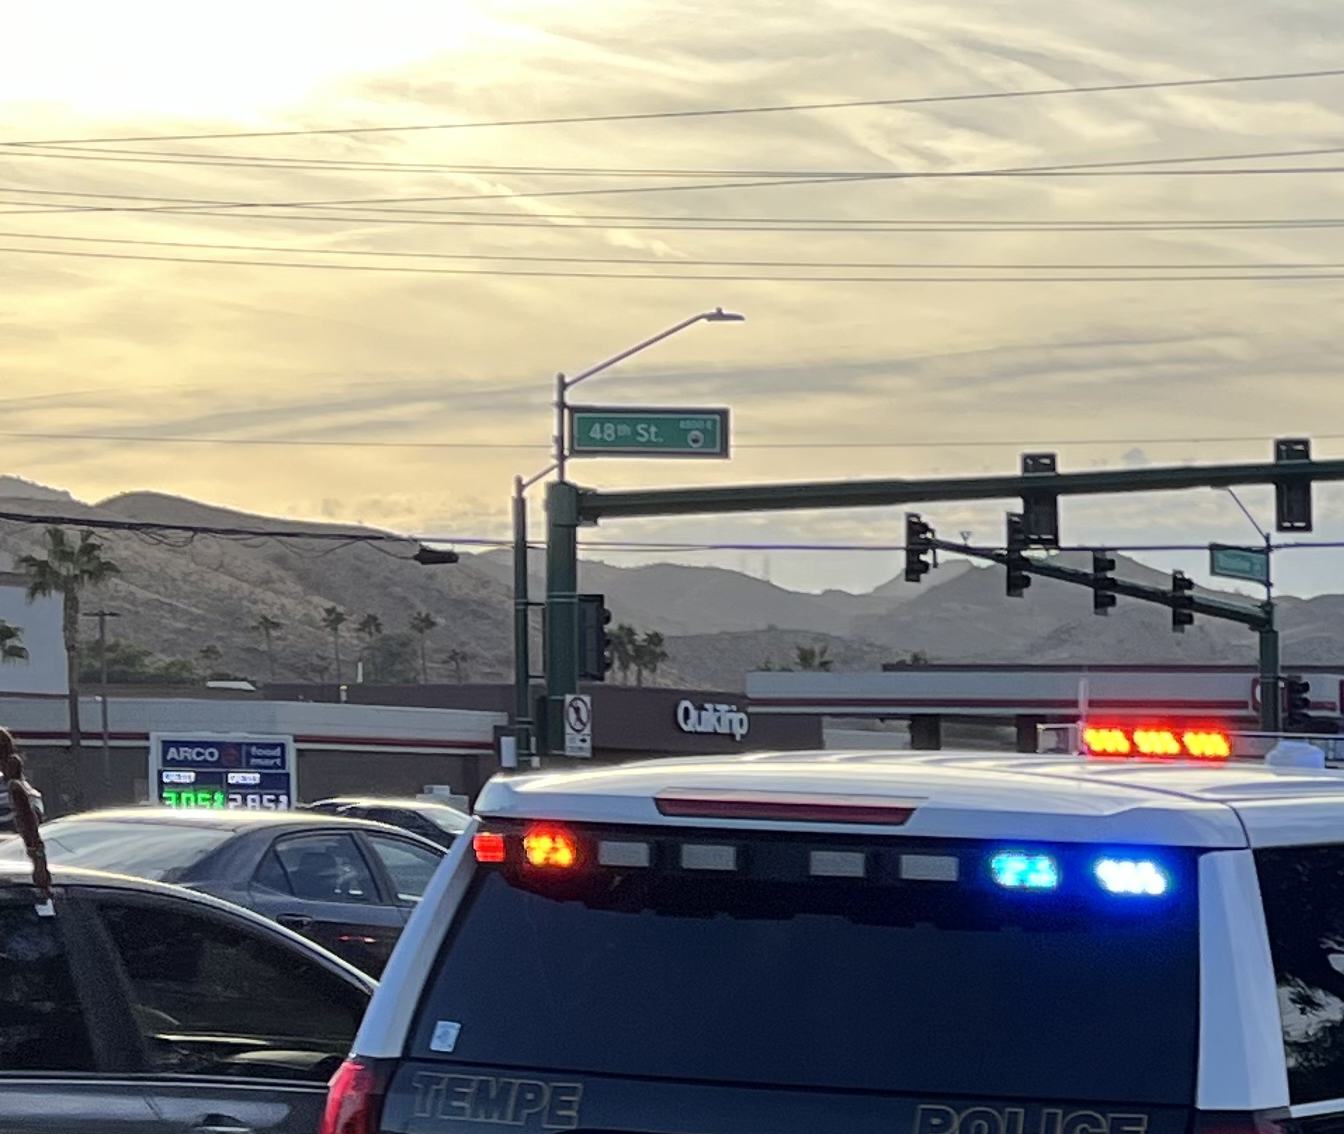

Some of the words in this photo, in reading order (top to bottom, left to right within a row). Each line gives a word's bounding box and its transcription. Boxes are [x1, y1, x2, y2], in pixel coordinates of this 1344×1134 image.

[588, 422, 632, 443] 48th
[677, 700, 749, 742] QuikTrip
[166, 747, 219, 761] ARCO
[412, 1071, 583, 1130] TEMPE
